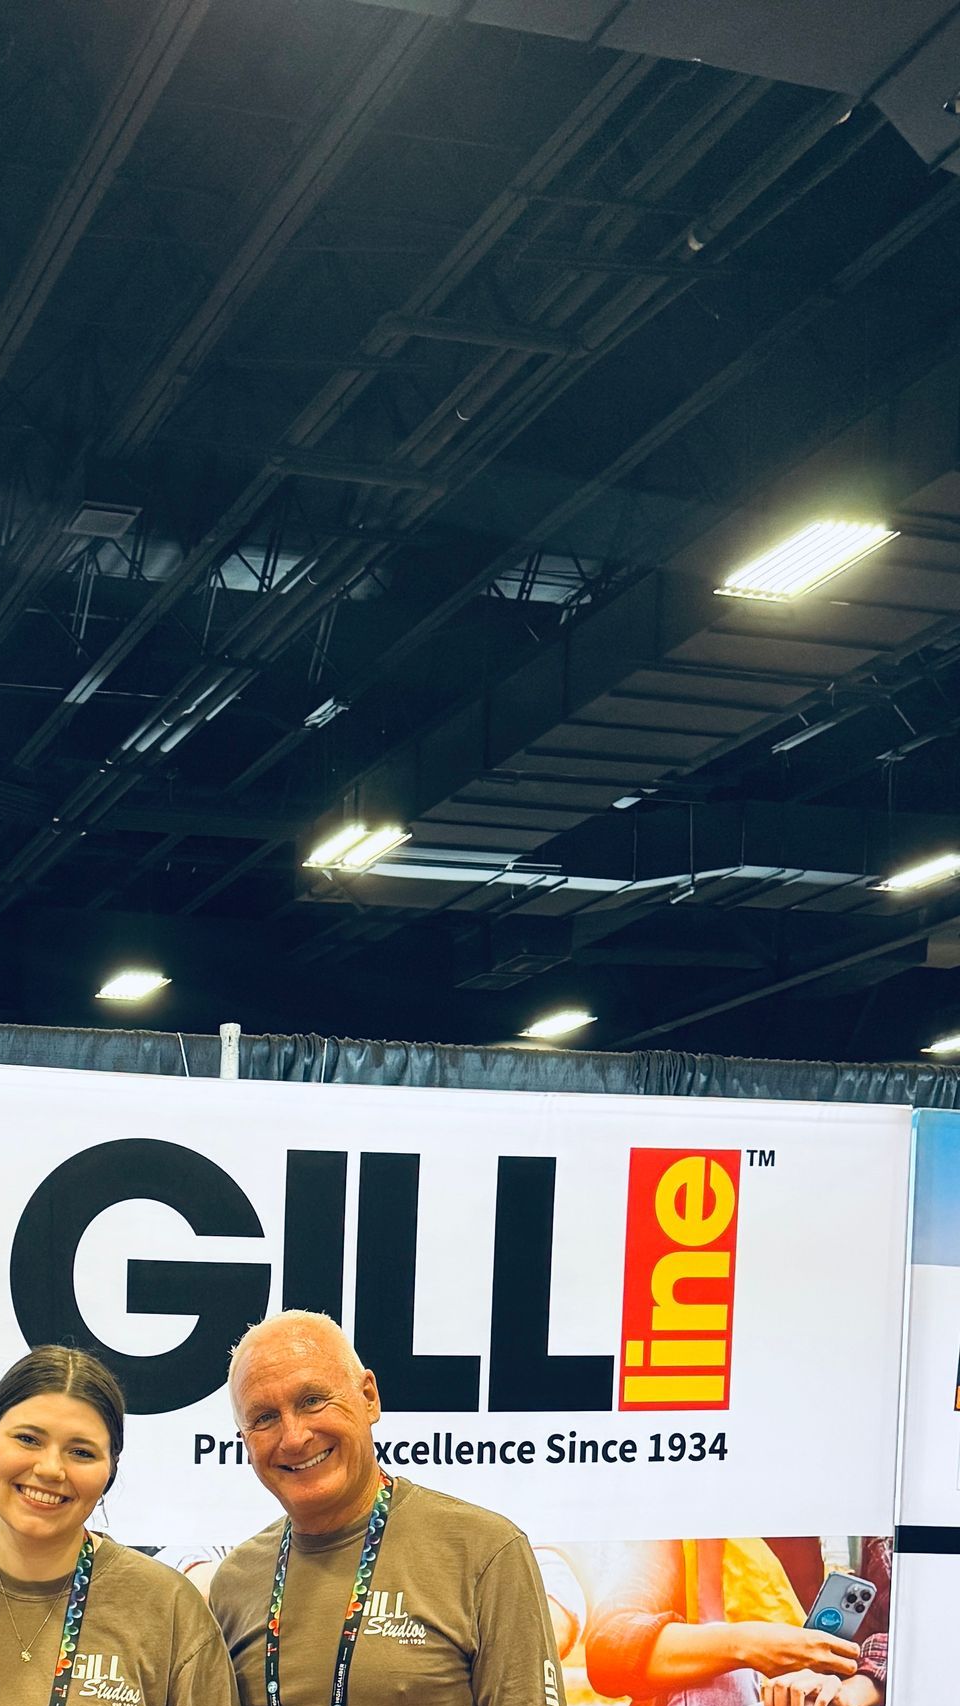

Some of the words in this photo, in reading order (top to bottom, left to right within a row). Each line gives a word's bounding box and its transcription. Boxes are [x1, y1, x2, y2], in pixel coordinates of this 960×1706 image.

[746, 1149, 775, 1167] TM
[8, 1137, 614, 1415] GILL
[622, 1155, 736, 1403] line
[376, 1431, 535, 1466] xcellence
[546, 1432, 637, 1464] Since
[647, 1432, 728, 1462] 1934
[363, 1617, 426, 1639] Studios
[71, 1654, 125, 1682] GILL
[79, 1678, 141, 1704] Studios
